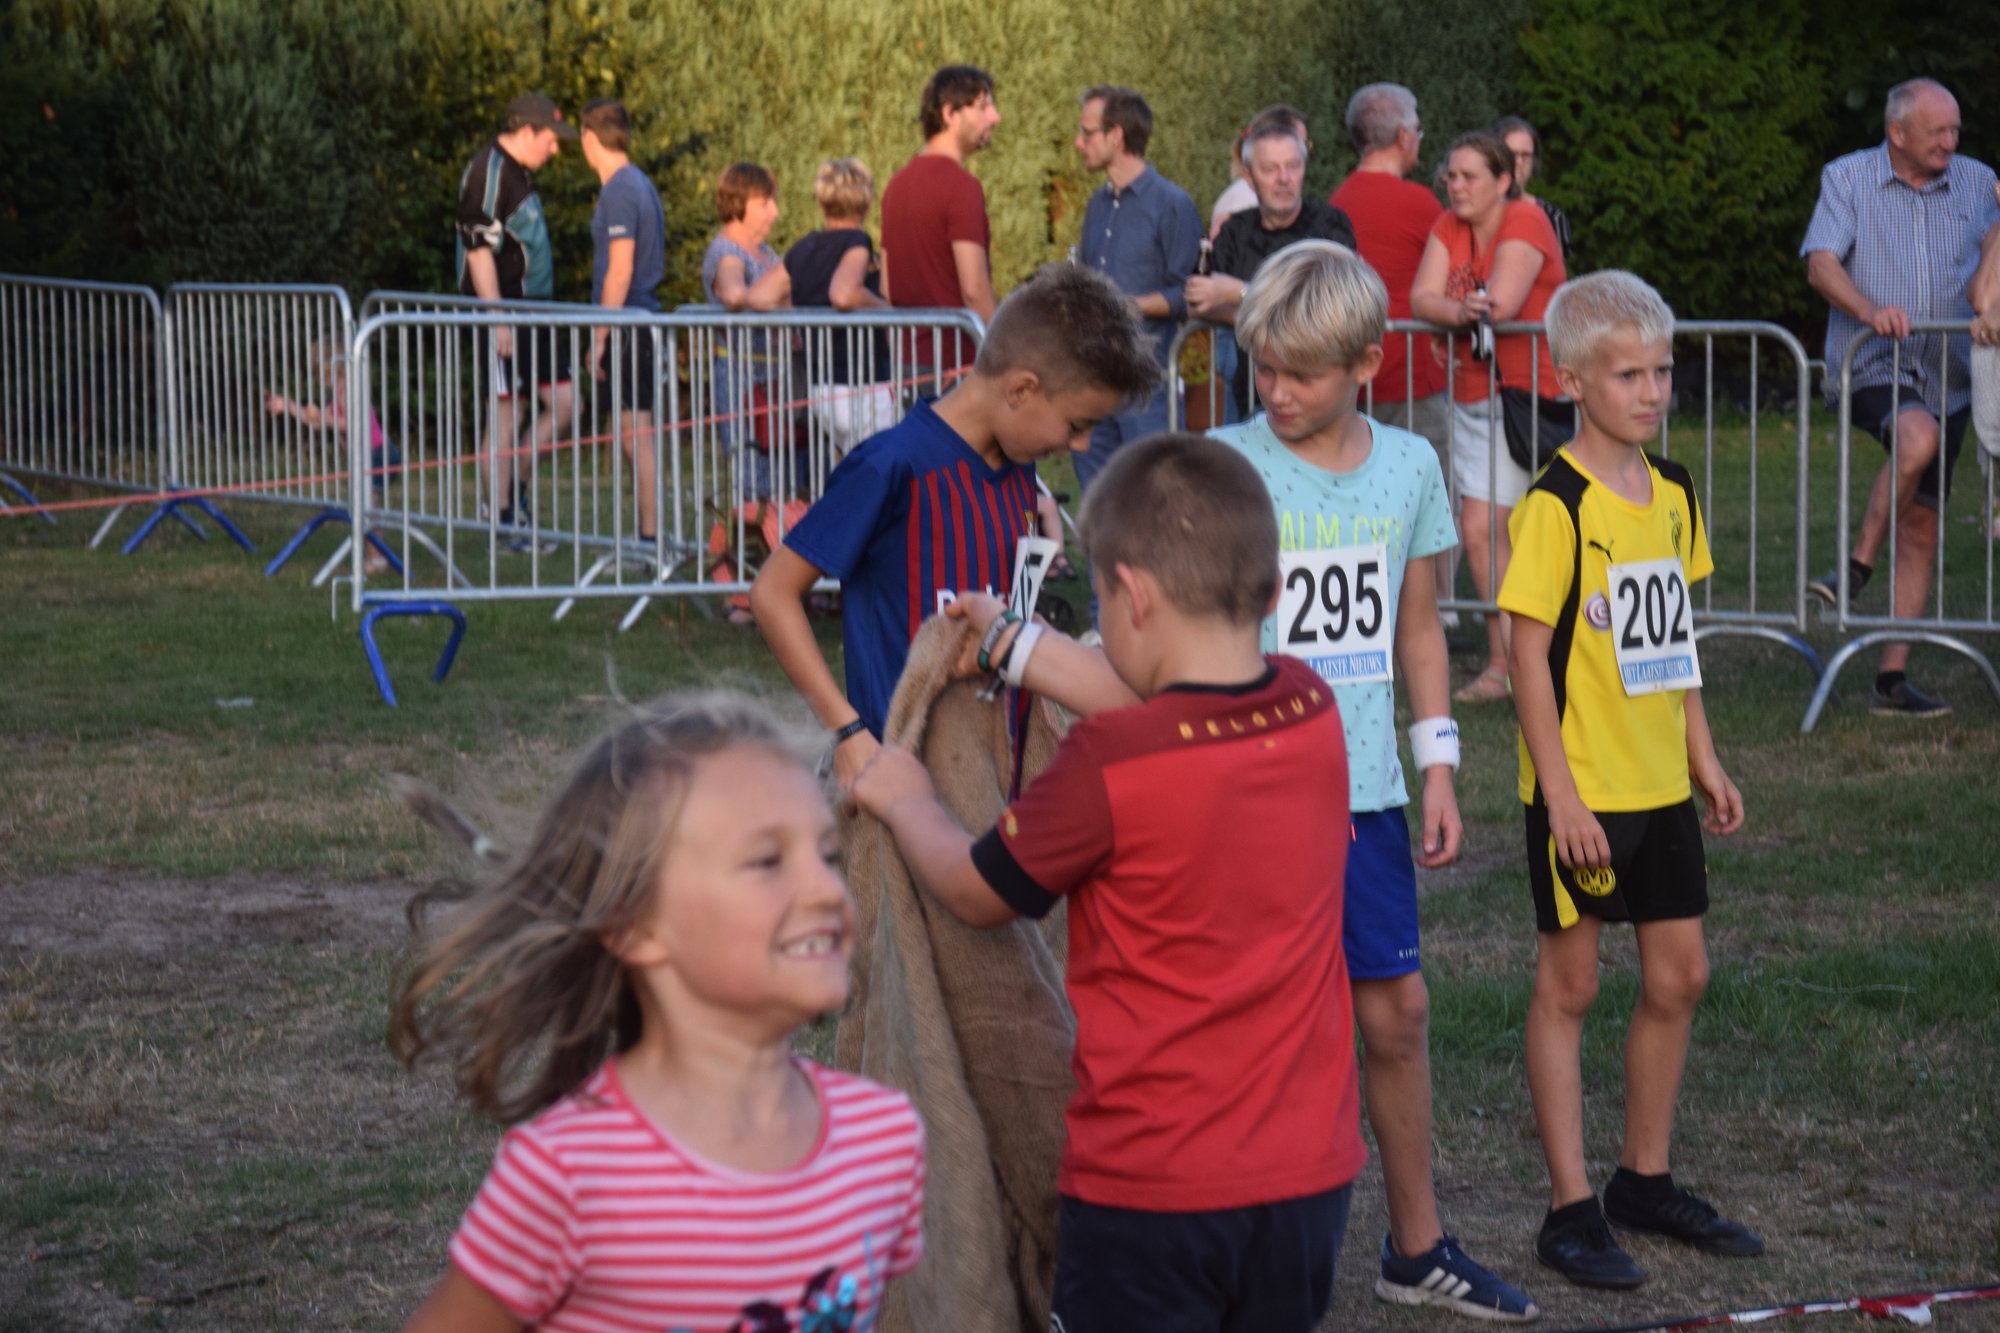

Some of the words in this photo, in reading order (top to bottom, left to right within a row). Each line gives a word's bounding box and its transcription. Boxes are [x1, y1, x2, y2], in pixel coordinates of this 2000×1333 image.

[1279, 511, 1341, 552] ALM
[1286, 562, 1382, 644] 295
[1618, 571, 1688, 650] 202
[1349, 653, 1382, 675] NIEUWS
[1636, 662, 1665, 683] LAATSTE
[1665, 656, 1689, 680] NIEUWS
[1178, 688, 1321, 740] BELGIUM
